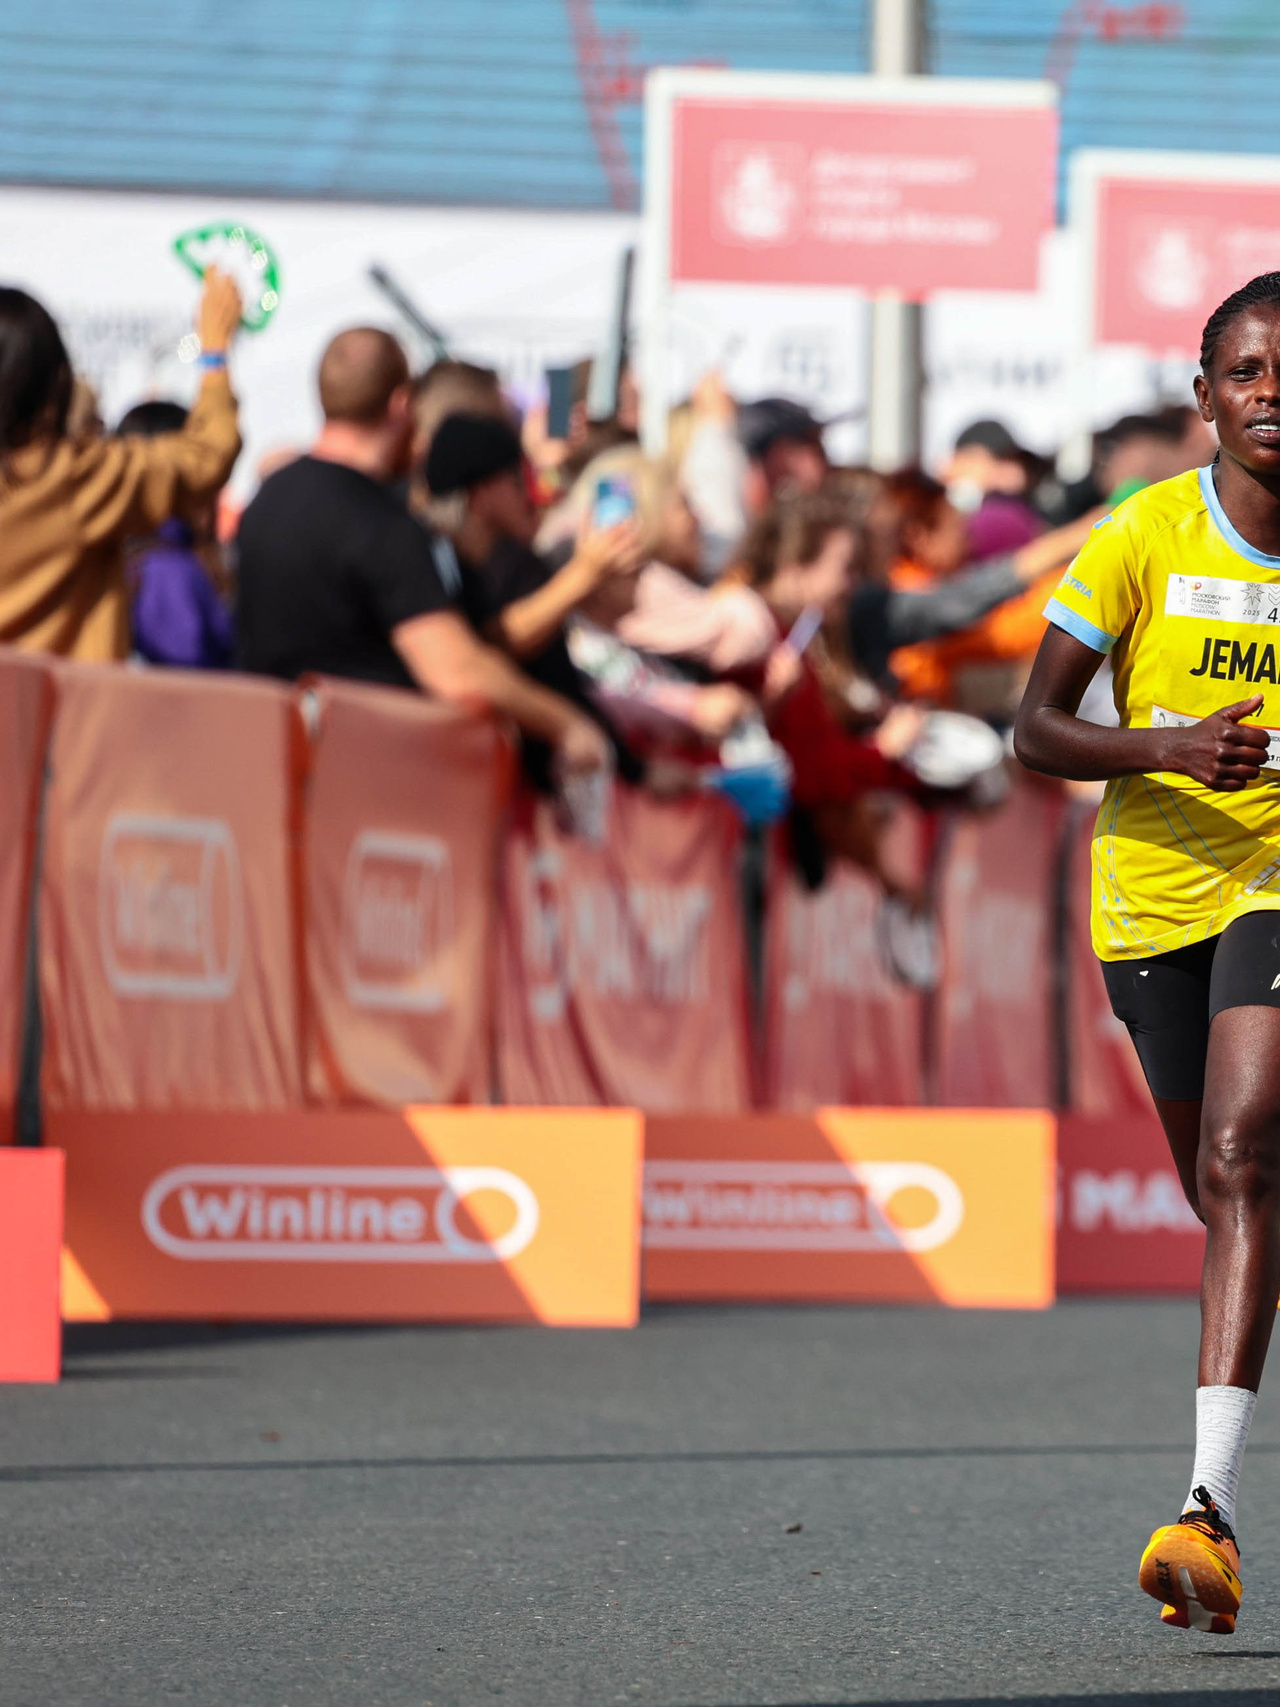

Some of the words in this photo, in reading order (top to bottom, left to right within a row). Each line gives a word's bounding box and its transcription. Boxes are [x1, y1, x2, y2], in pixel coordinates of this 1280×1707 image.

[1191, 597, 1220, 606] МАРАФОН
[1190, 607, 1221, 616] MARATHON
[1242, 609, 1260, 617] 2025
[179, 1184, 427, 1241] Winline
